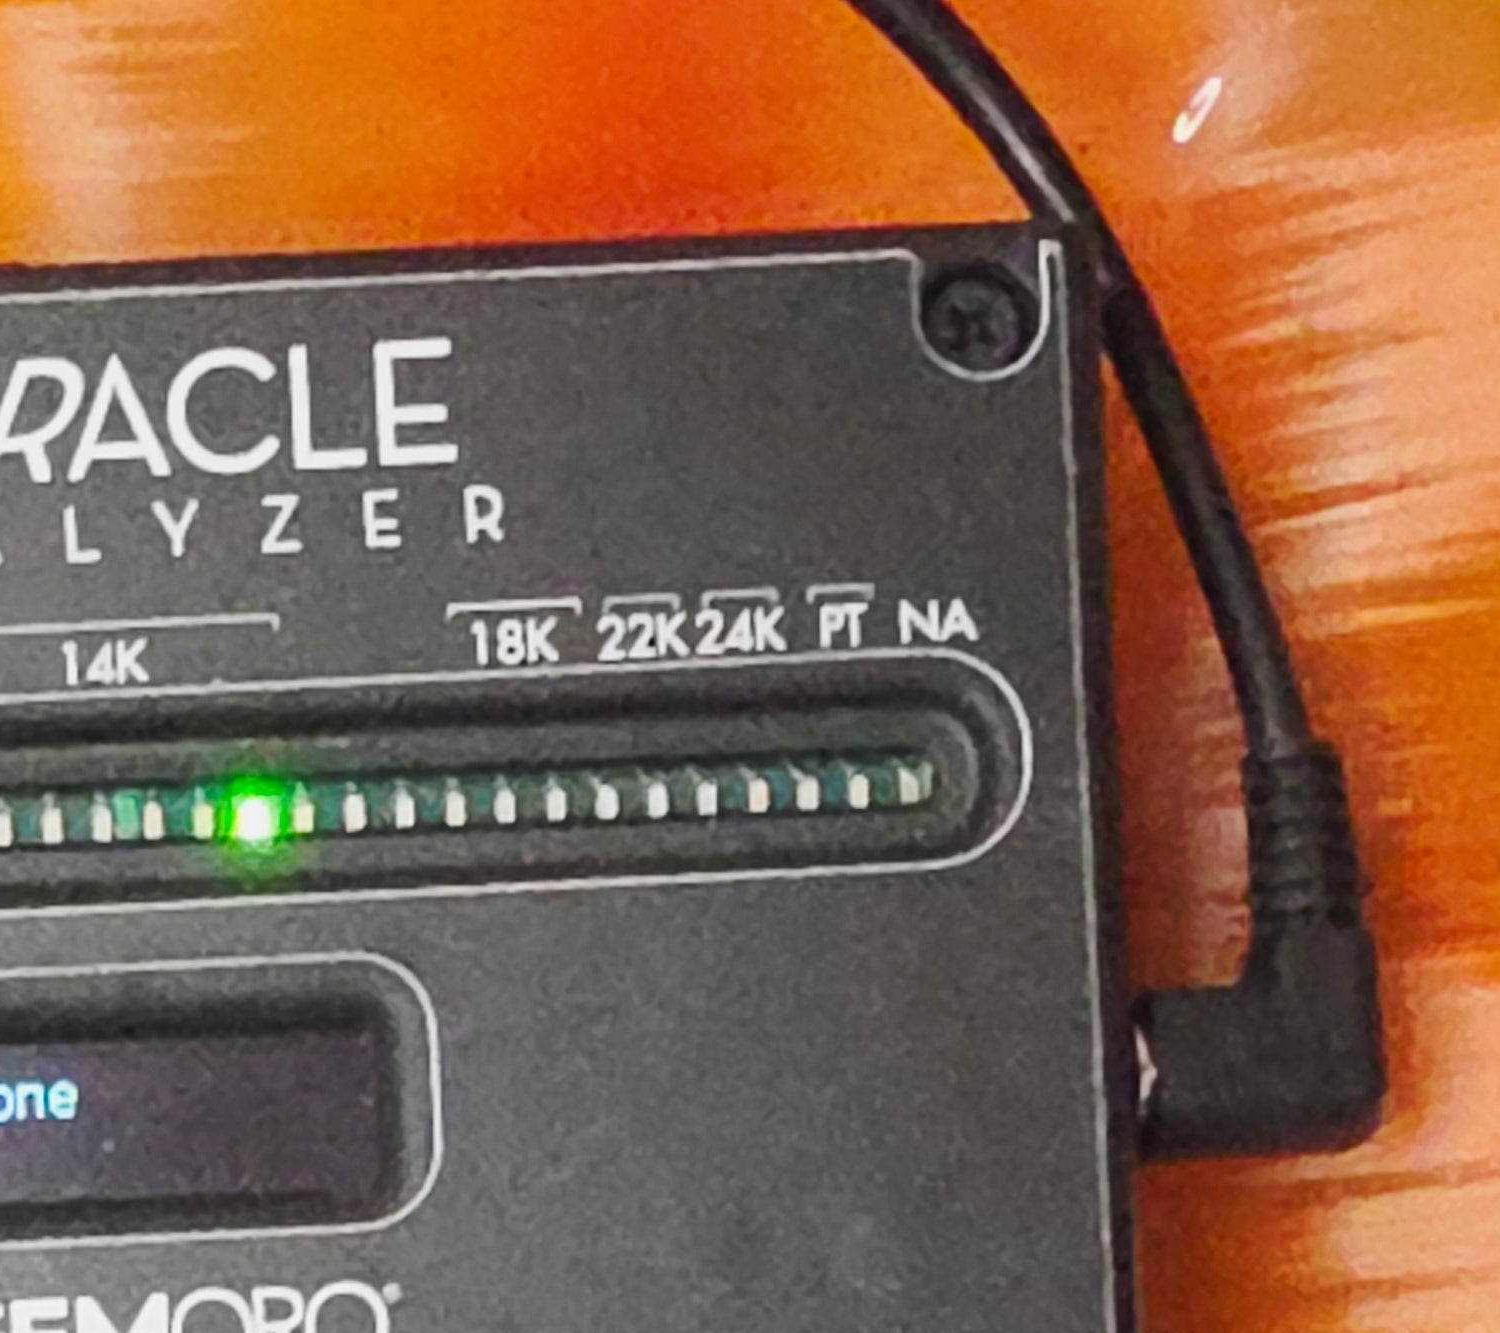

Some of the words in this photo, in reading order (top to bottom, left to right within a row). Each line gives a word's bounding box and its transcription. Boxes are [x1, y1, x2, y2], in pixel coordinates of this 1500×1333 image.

[62, 638, 150, 687] 14K
[471, 616, 560, 666] 18K
[597, 611, 690, 662] 22K
[695, 605, 787, 655] 24K
[819, 602, 868, 648] PT
[900, 598, 979, 644] NA
